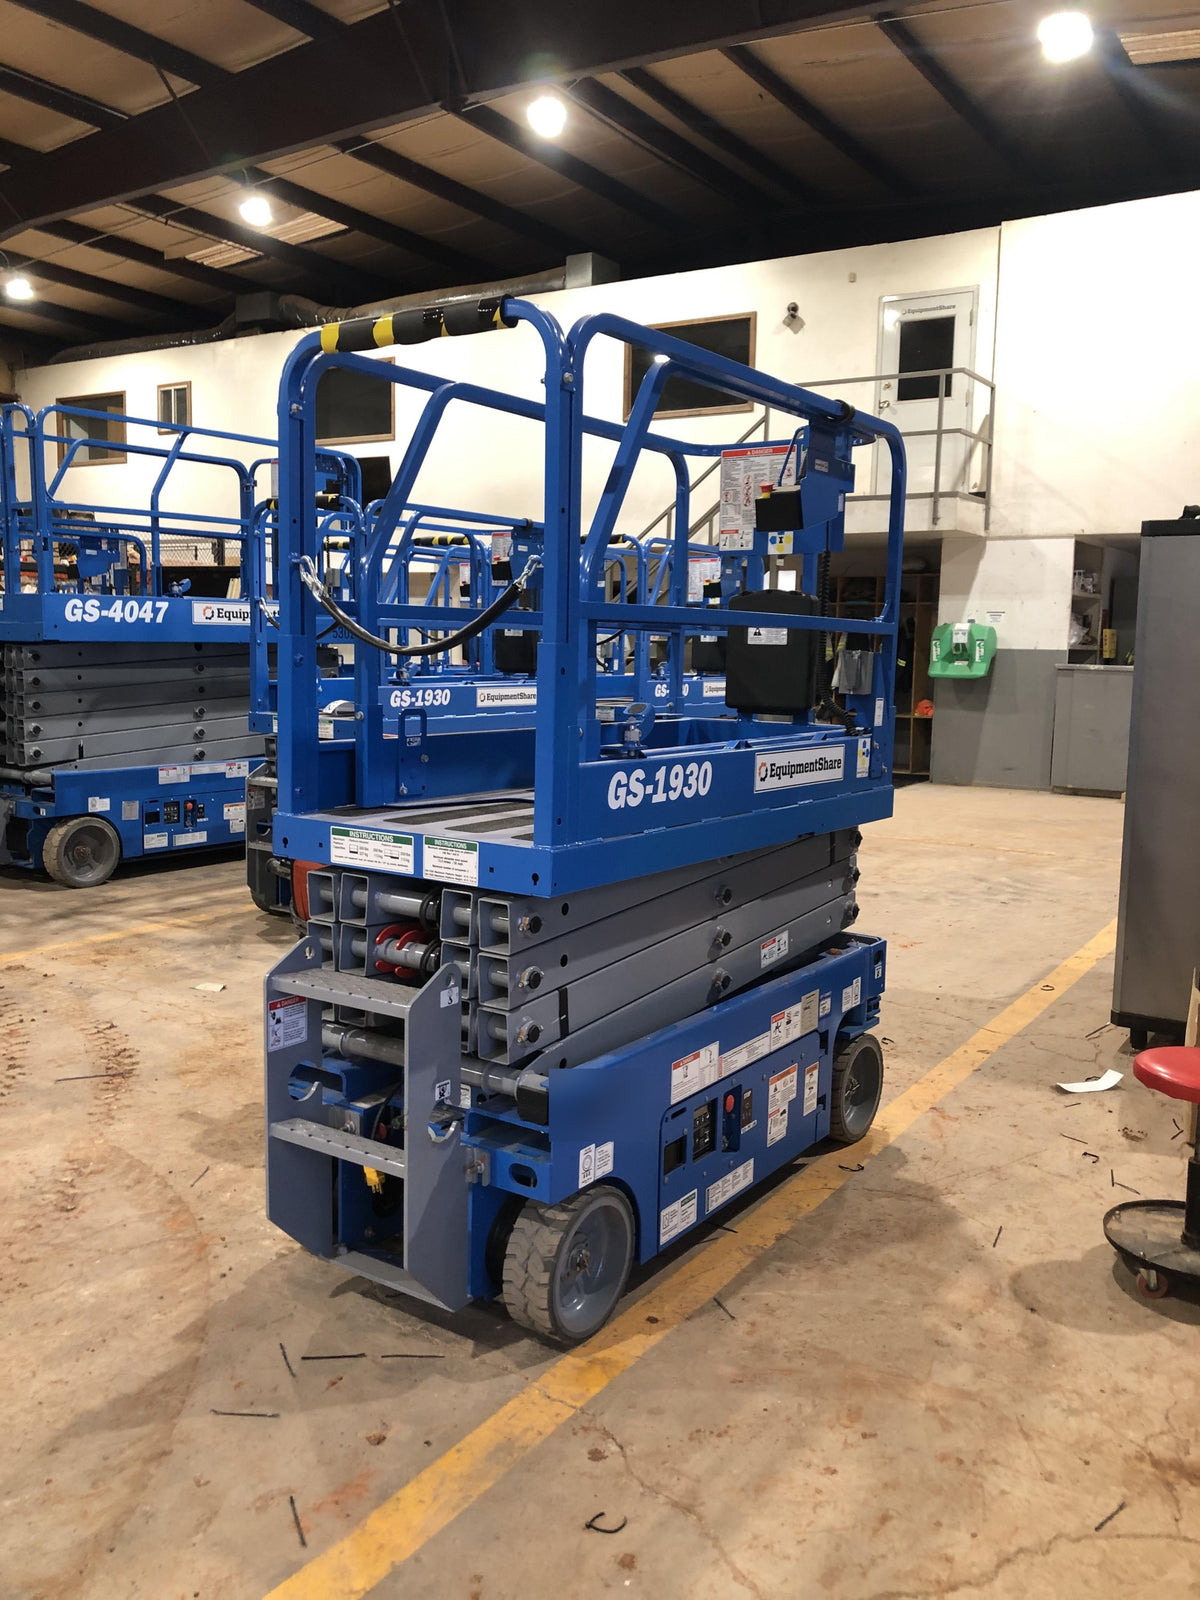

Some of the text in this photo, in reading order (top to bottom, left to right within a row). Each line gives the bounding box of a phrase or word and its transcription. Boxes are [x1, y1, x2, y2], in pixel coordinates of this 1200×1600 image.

[64, 598, 169, 623] GS-4047
[390, 688, 451, 708] GS-1930
[486, 691, 537, 702] EquipmentShare
[769, 756, 842, 780] EquipmentShare
[607, 760, 713, 810] GS-1930
[348, 830, 394, 843] INSTRUCTIONS
[434, 839, 467, 850] INSTRUCTIONS
